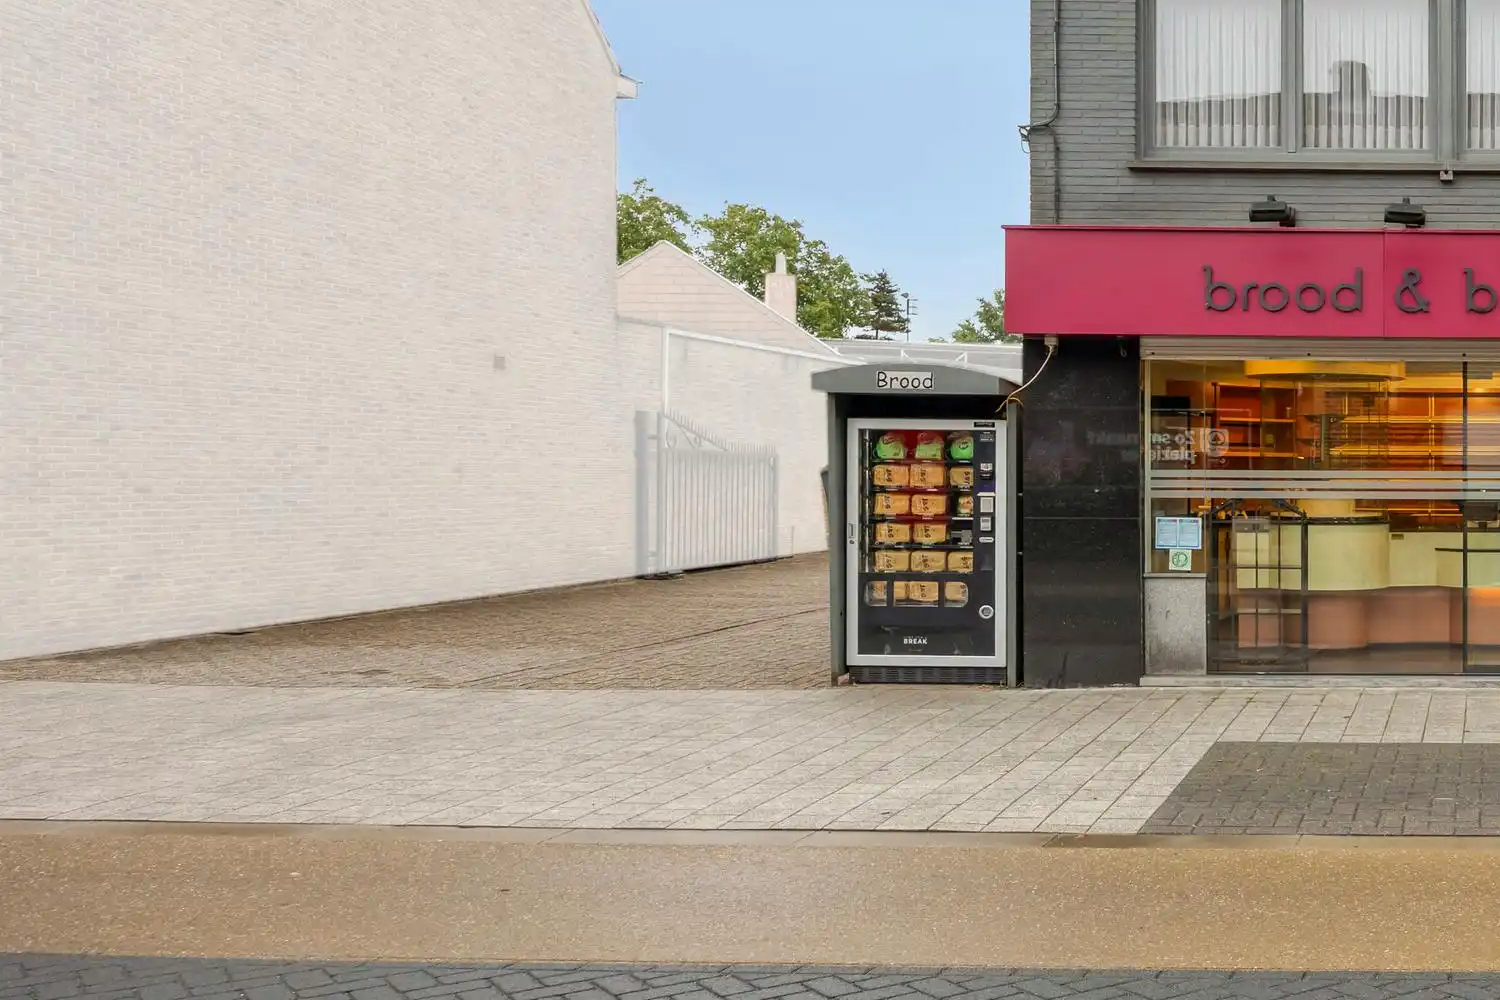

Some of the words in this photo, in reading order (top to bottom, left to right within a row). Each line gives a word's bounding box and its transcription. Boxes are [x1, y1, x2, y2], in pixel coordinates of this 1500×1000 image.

[1202, 264, 1363, 314] brood
[1394, 267, 1430, 313] &
[877, 371, 934, 389] Brood
